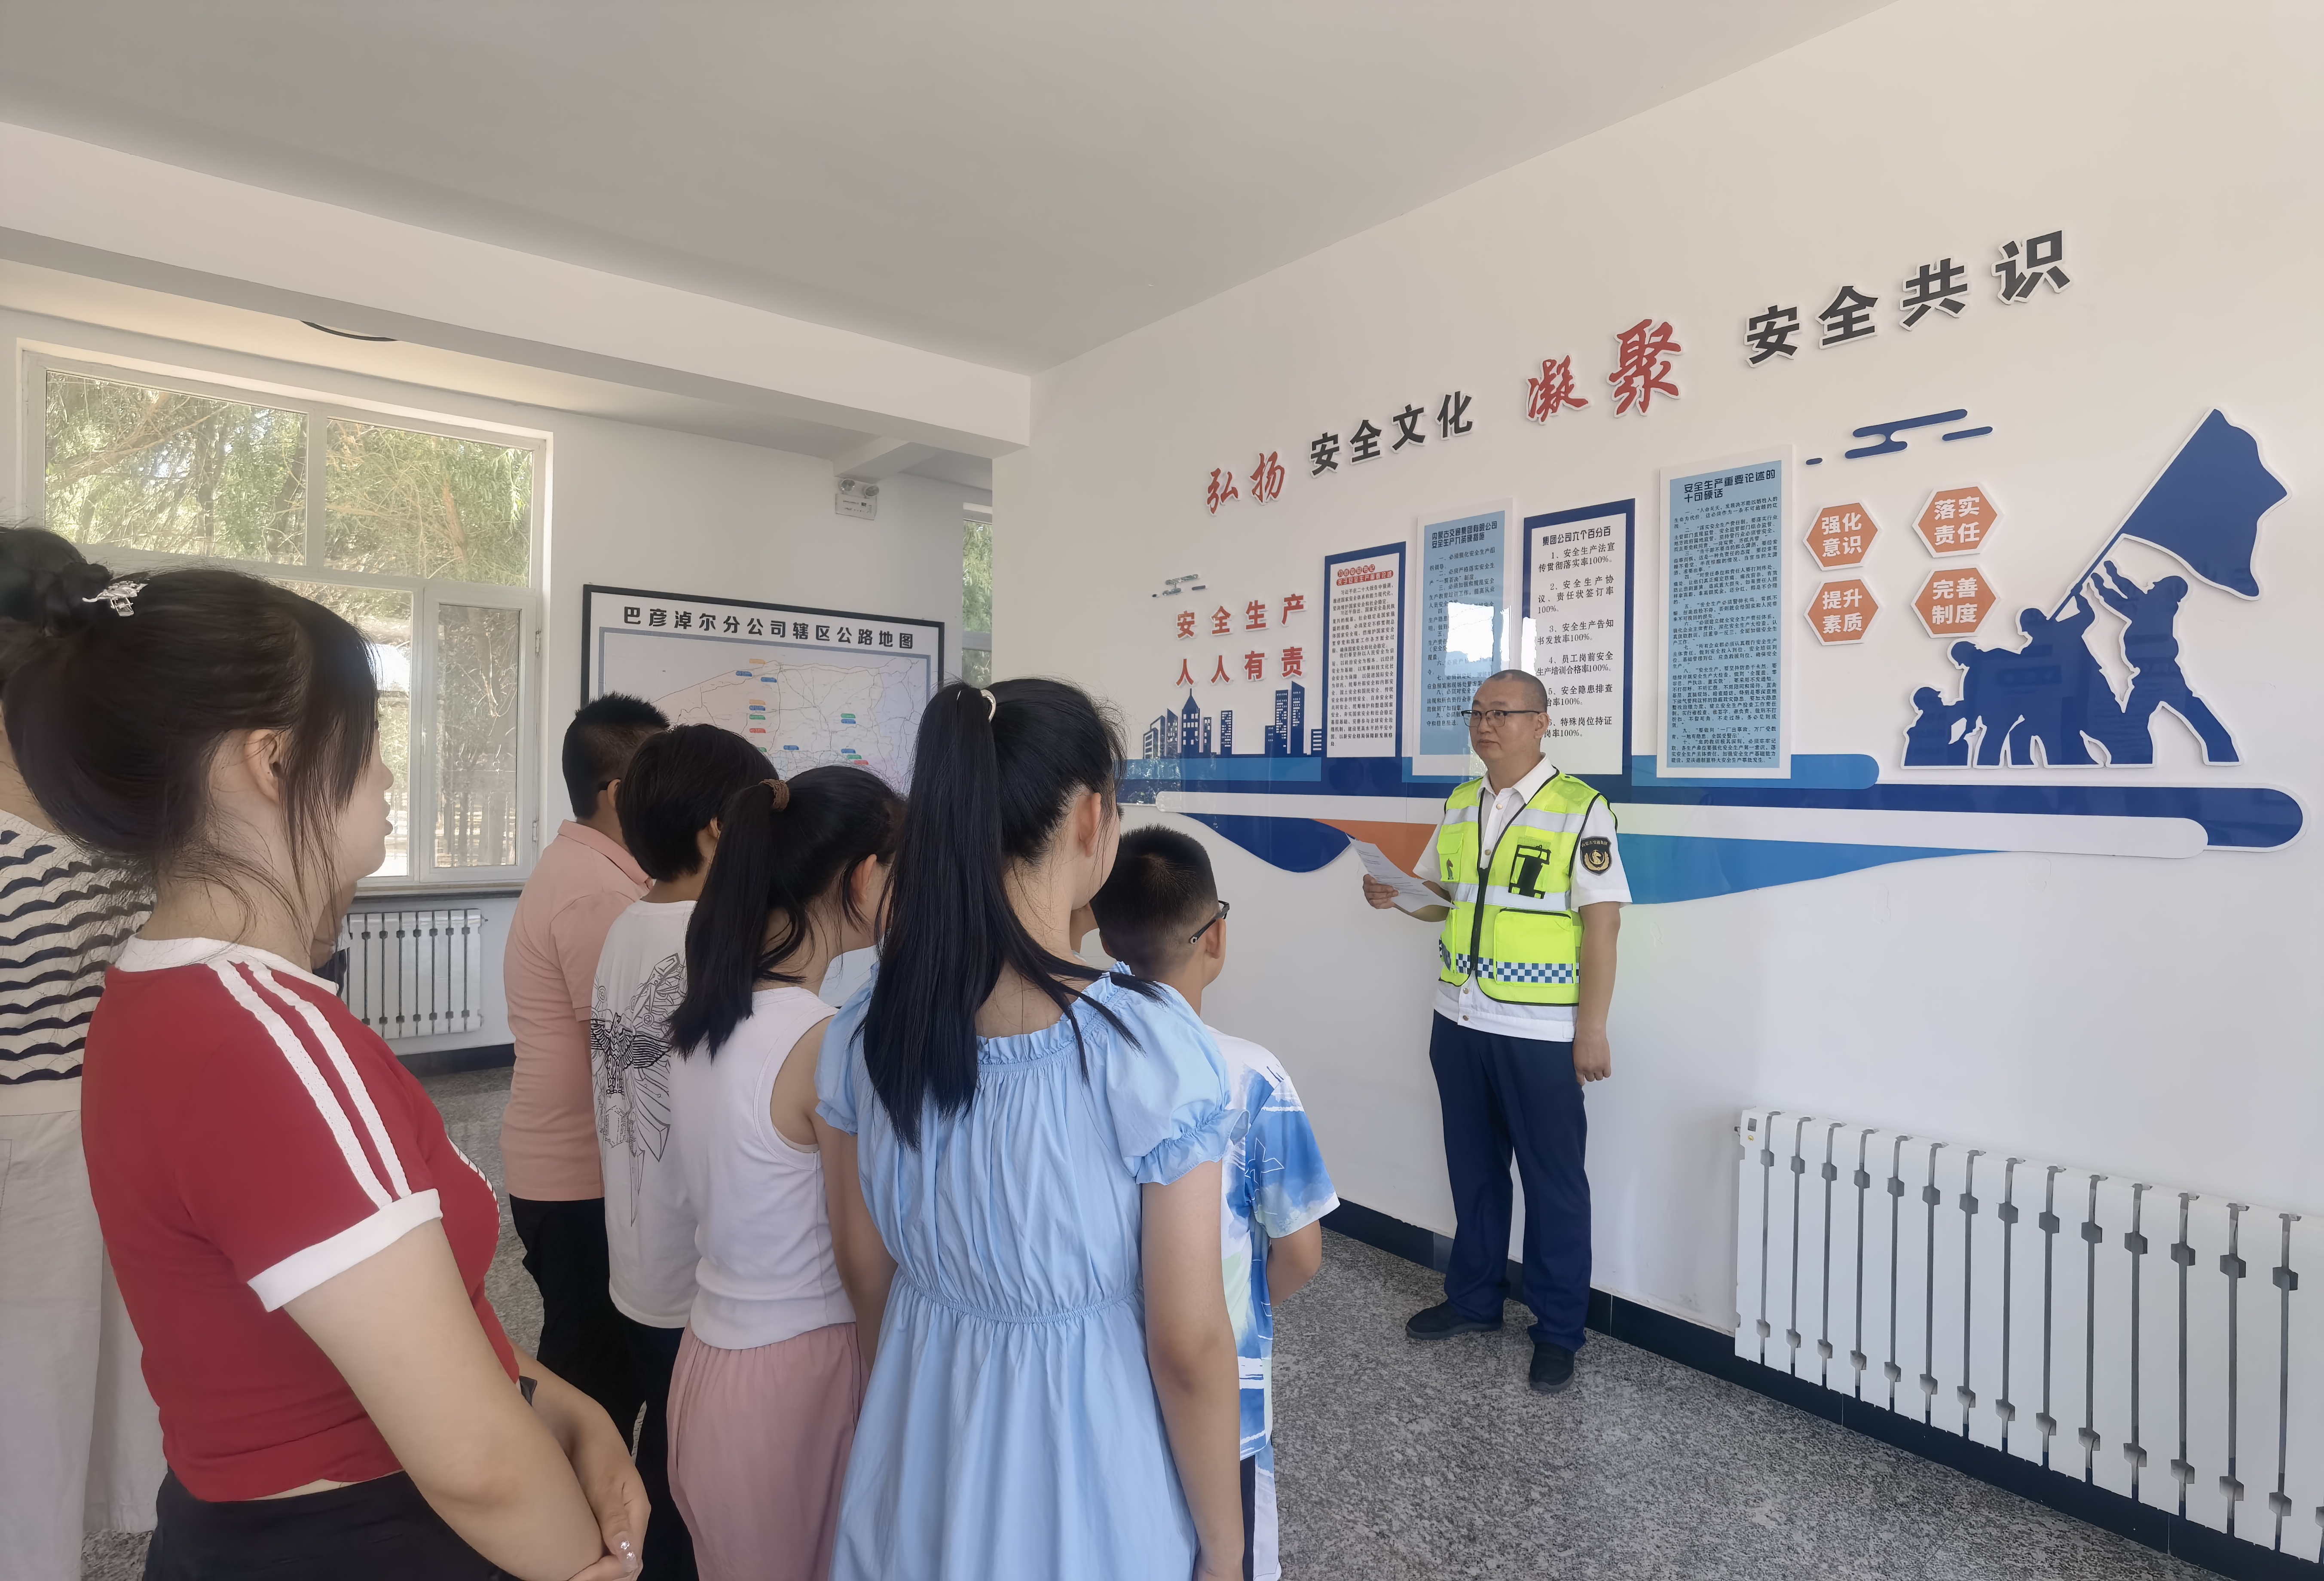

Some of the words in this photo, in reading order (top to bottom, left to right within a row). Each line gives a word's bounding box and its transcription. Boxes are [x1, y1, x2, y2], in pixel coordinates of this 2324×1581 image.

[1207, 451, 1285, 514] 弘扬
[1310, 391, 1474, 476] 安全文化
[1528, 319, 1682, 421] 凝聚
[1747, 230, 2070, 365] 安全共识
[1684, 469, 1775, 494] 安全生产重要论述的
[1684, 488, 1723, 503] 十句硬话
[1934, 496, 1980, 520] 落实
[1432, 521, 1497, 540] 内蒙古交通集团有限公司
[1821, 512, 1862, 535] 强化
[1934, 522, 1980, 545] 责任
[1542, 526, 1611, 546] 集团公司六个百分百
[1822, 536, 1862, 557] 意识
[1538, 555, 1612, 573] 传贯彻落实率100%。
[1538, 586, 1614, 603] 议、责任状签订率
[1823, 588, 1862, 610] 提升
[1933, 577, 1978, 600] 完善
[1177, 593, 1304, 638] 安全生产
[1538, 605, 1559, 614] 100%。
[1931, 603, 1978, 625] 制度
[624, 606, 913, 649] 巴彦淖尔分公司辖区公路地图
[1823, 612, 1862, 634] 素质
[1537, 633, 1592, 645] 书发放率100%。
[1176, 646, 1303, 686] 人人有责
